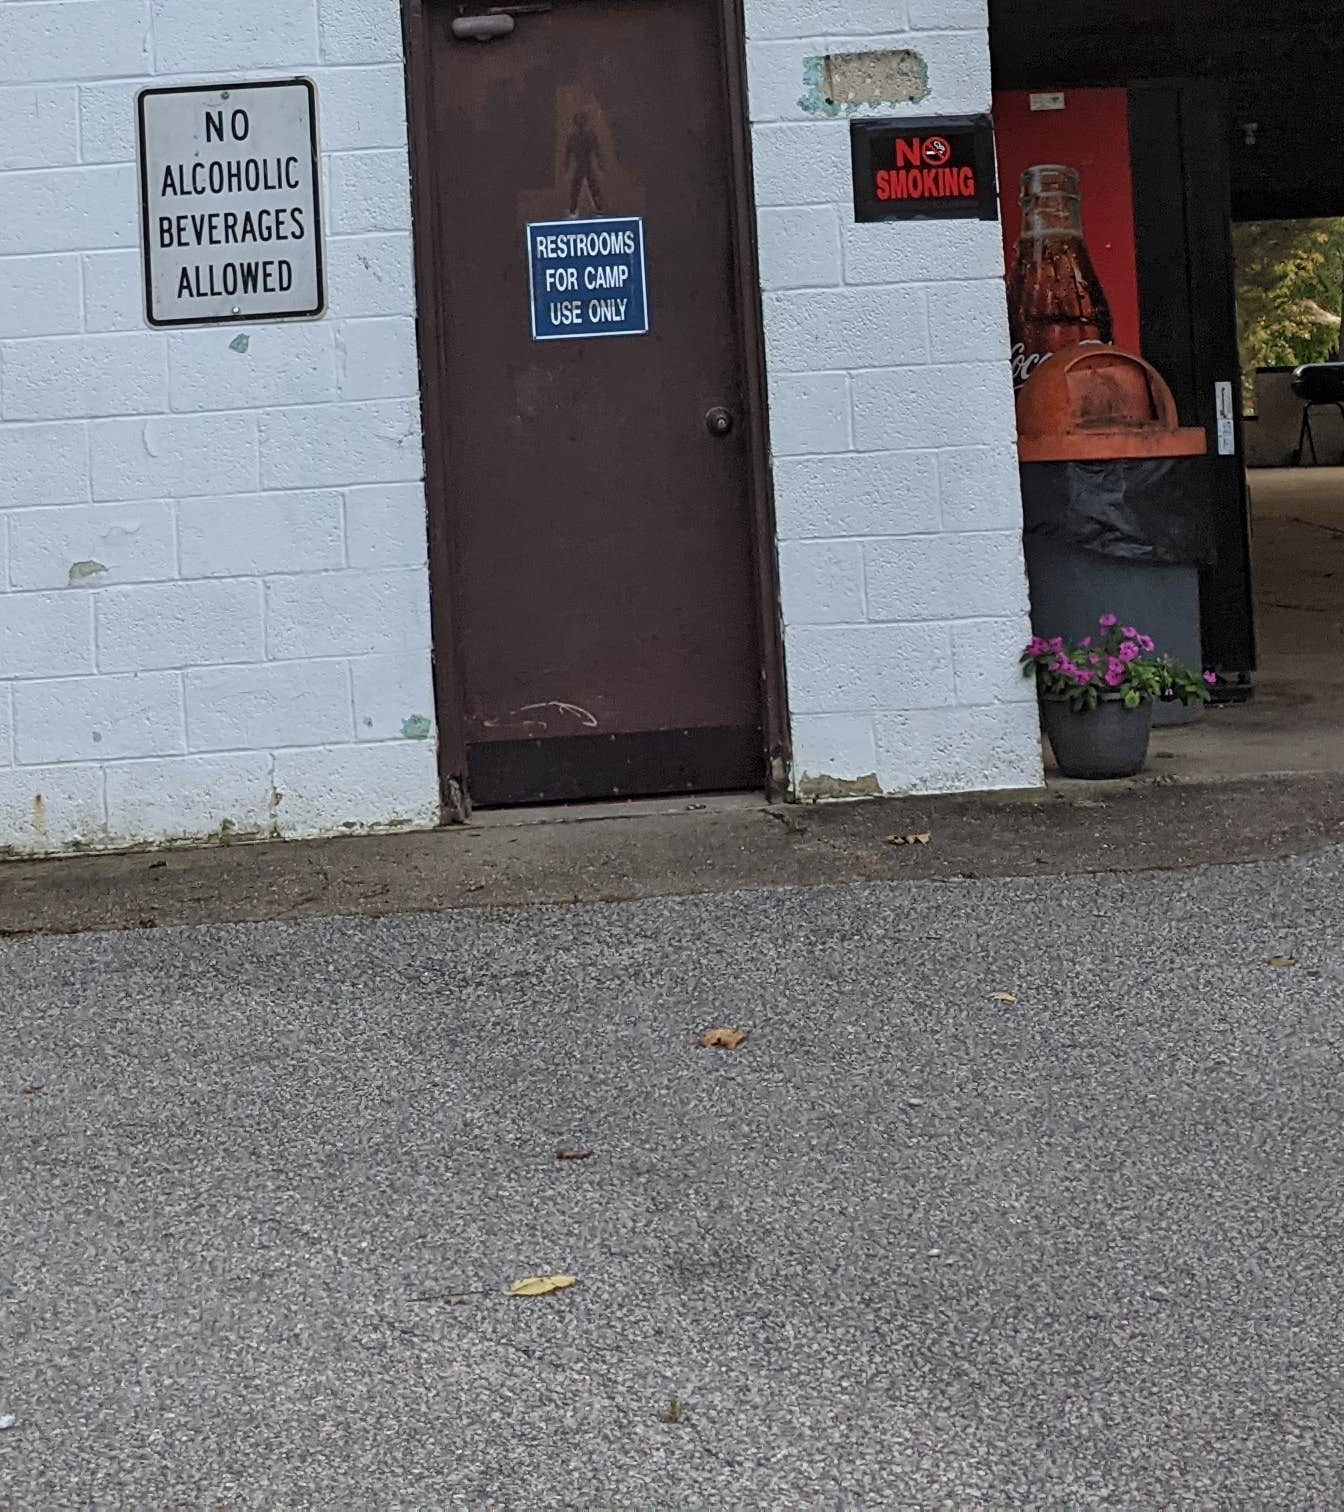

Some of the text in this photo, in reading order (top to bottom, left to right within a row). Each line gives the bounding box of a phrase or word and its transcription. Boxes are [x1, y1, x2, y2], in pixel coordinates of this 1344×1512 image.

[205, 109, 249, 142] NO
[161, 156, 300, 196] ALCOHOLIC
[876, 166, 975, 200] SMOKING
[159, 207, 305, 248] BEVERAGES
[536, 231, 635, 259] RESTROOMS
[177, 260, 293, 299] ALLOWED
[545, 265, 629, 292] FOR CAMP
[550, 298, 628, 326] USE ONLY
